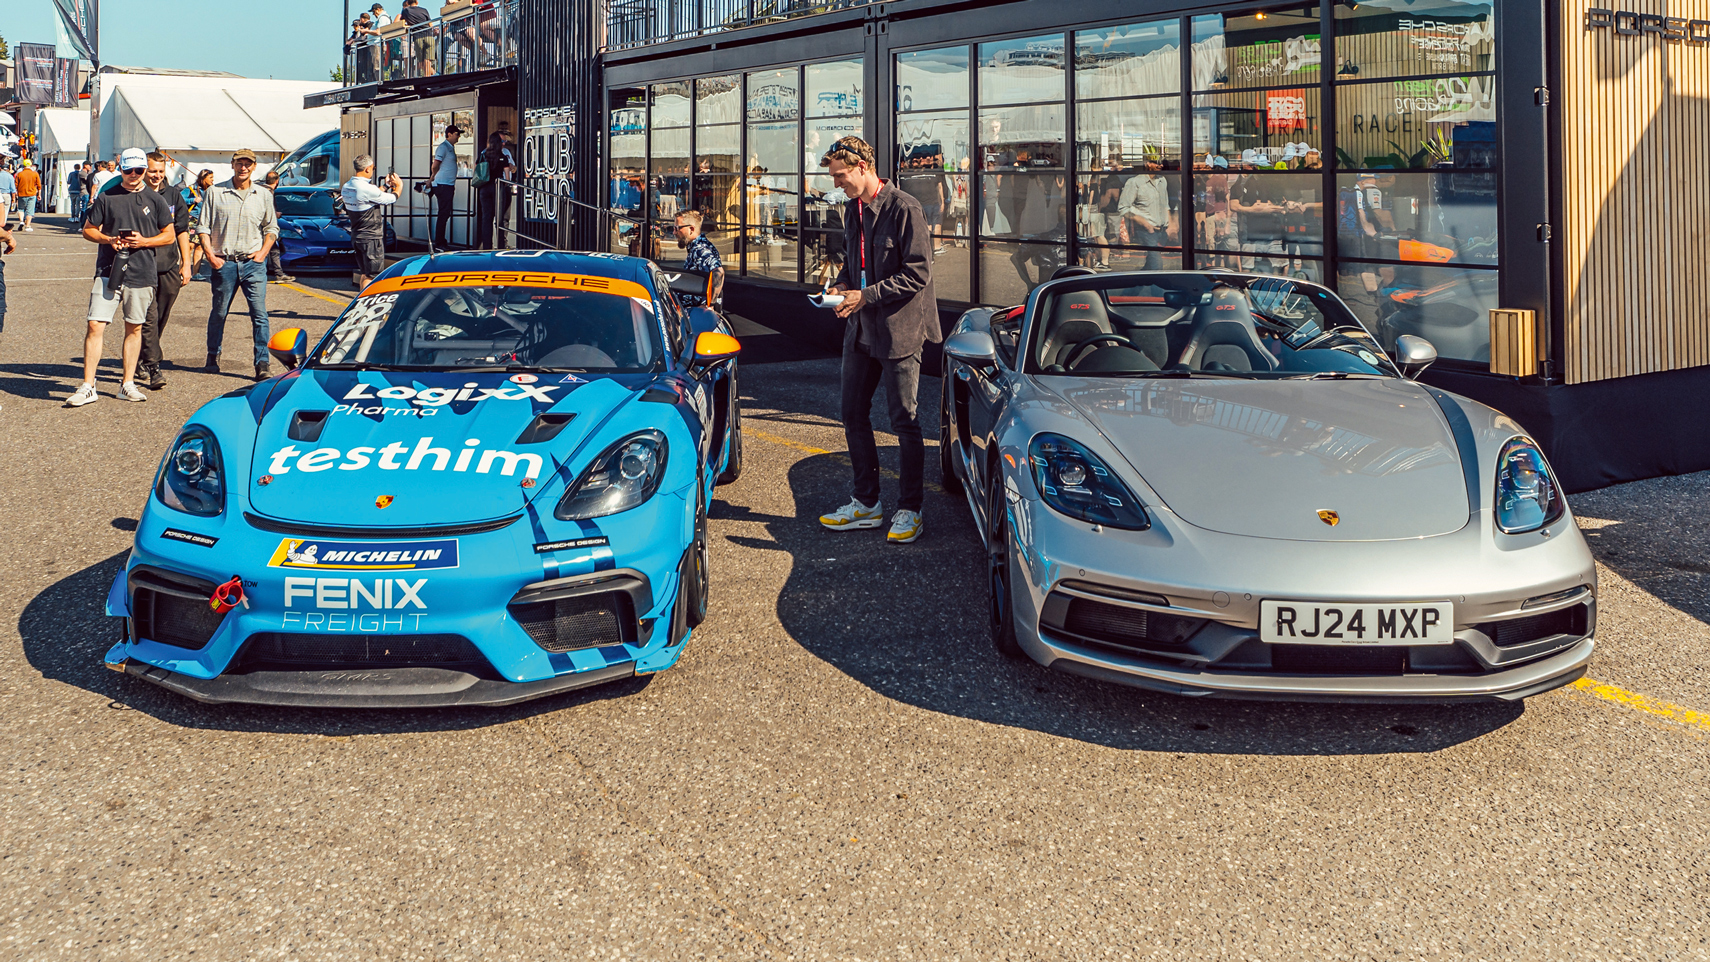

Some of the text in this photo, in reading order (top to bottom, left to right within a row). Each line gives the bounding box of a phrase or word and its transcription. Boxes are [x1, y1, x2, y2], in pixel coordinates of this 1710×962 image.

[524, 105, 571, 119] PORSCHE
[524, 133, 571, 176] CLUB
[401, 274, 610, 290] PORSCHE
[355, 293, 400, 309] Trice
[330, 402, 439, 416] Pharma
[268, 437, 544, 479] testhim
[164, 530, 215, 545] PORSCHE DESIGN
[536, 538, 606, 551] PORSCHE DESIGN
[321, 549, 442, 562] MICHELIN
[244, 580, 258, 588] TOW
[284, 576, 428, 609] FENIX
[281, 611, 429, 632] FREIGHT
[1277, 606, 1440, 639] RJ24 MXP
